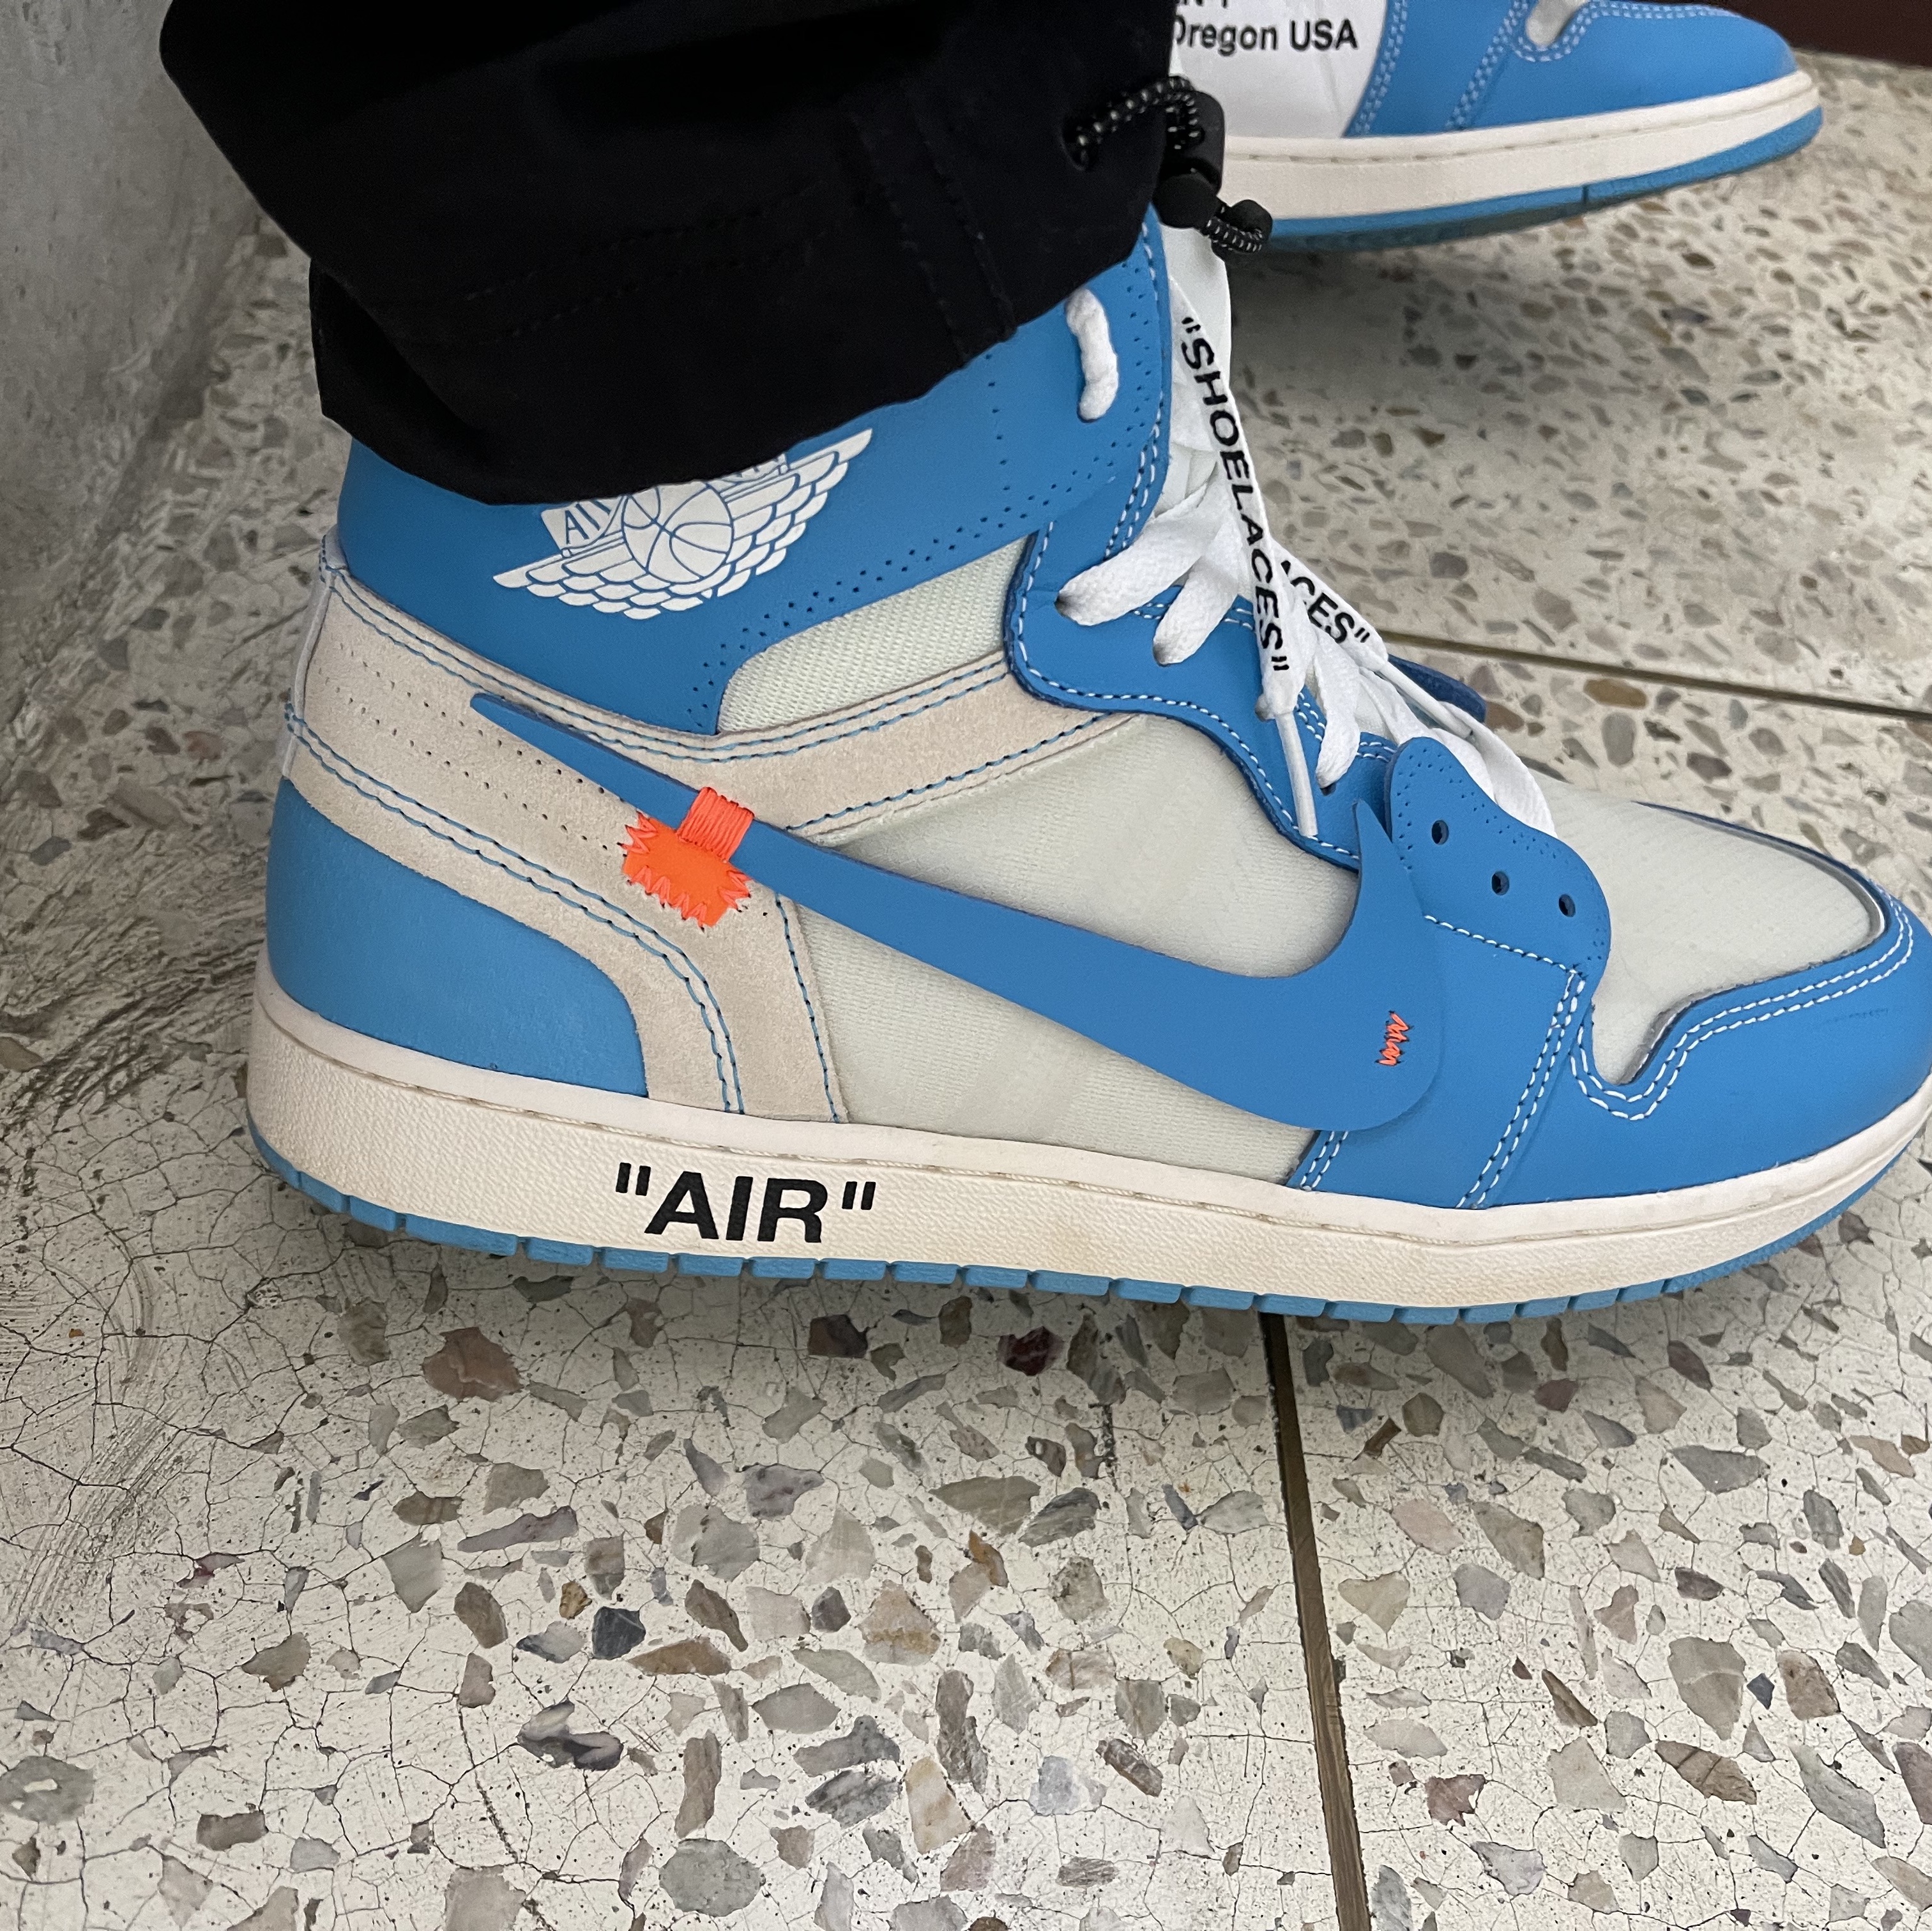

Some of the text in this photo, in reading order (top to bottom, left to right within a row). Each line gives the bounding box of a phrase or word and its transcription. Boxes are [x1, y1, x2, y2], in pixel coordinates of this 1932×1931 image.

[1289, 19, 1358, 51] USA
[1181, 317, 1290, 671] "SHOELACES"
[1281, 560, 1371, 644] CES"
[615, 1162, 876, 1243] "AIR"
